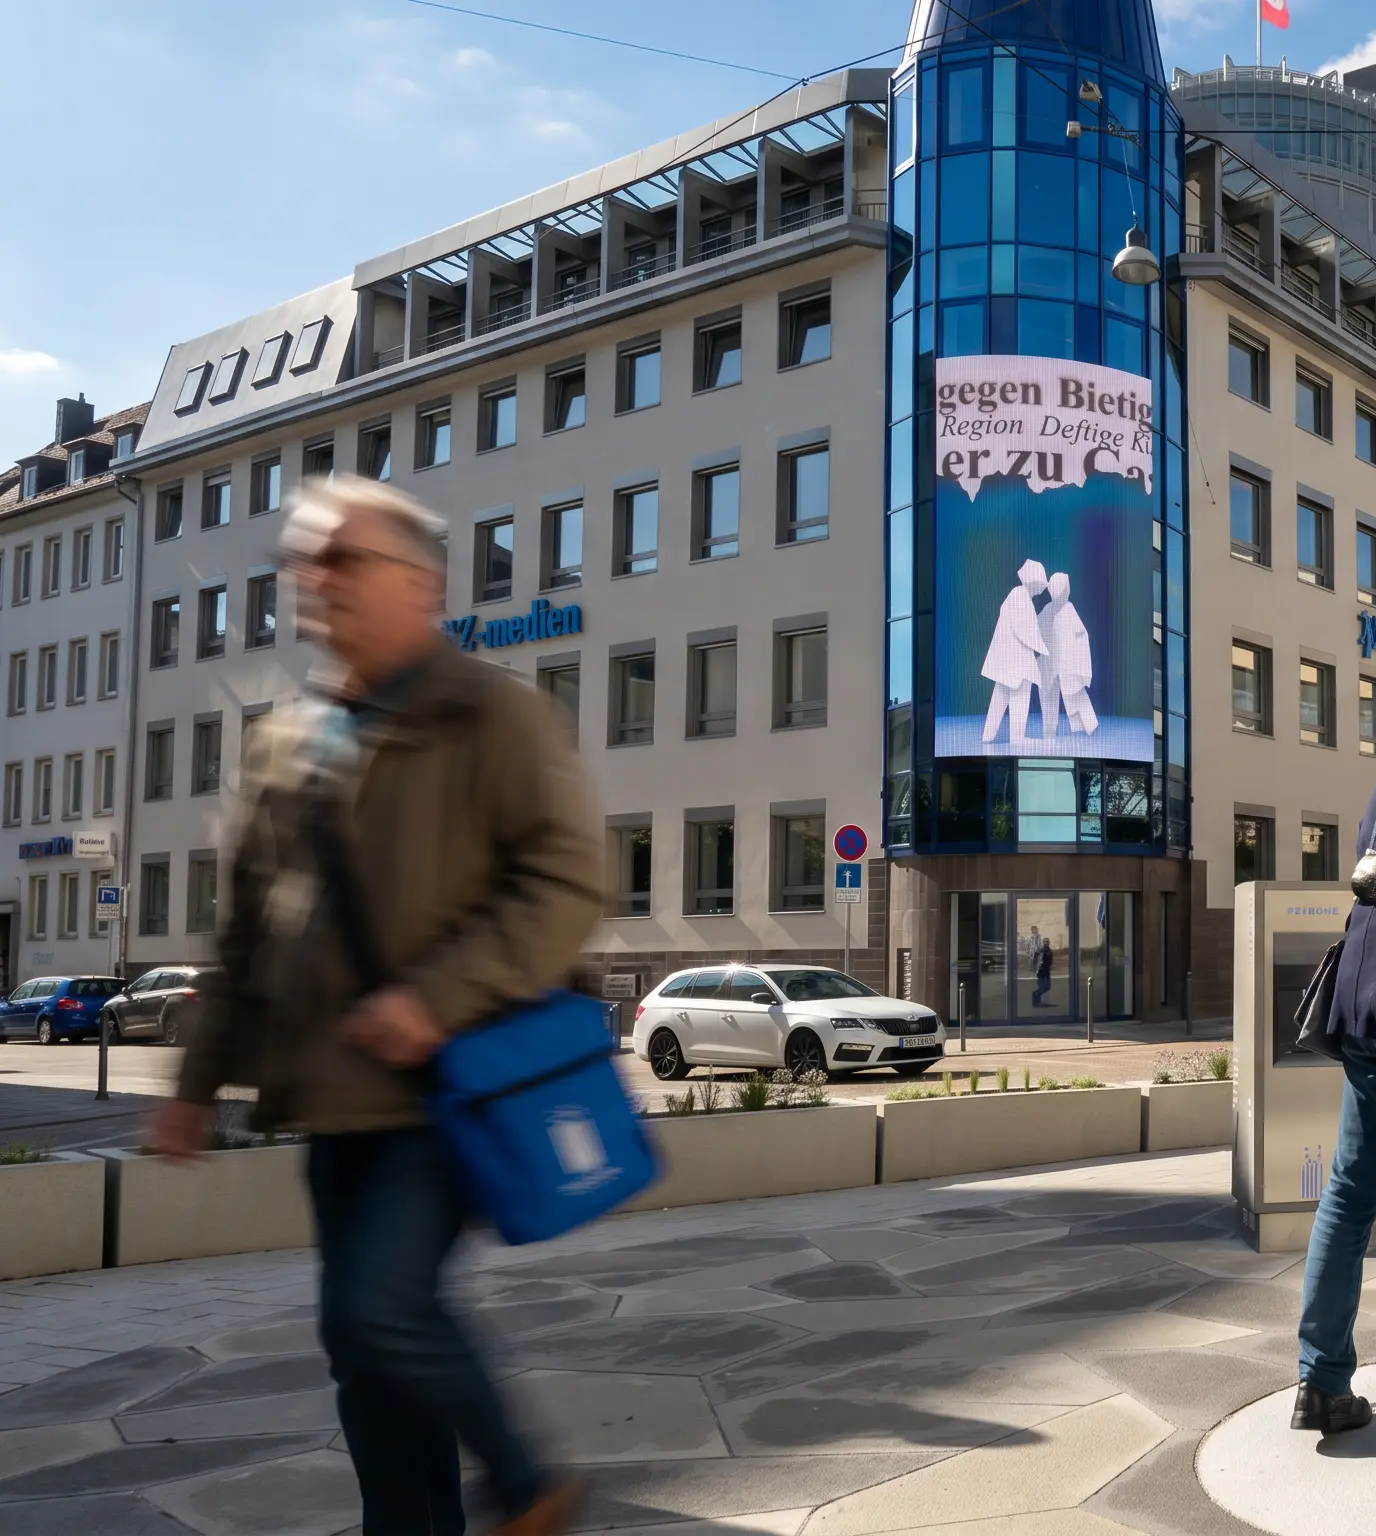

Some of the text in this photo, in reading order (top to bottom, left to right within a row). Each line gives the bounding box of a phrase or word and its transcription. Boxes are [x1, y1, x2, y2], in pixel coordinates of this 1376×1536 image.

[938, 377, 1152, 433] gegen Bietig
[940, 414, 1024, 441] Region
[1040, 415, 1124, 448] Deftige
[941, 449, 990, 479] er
[1006, 449, 1064, 482] zu
